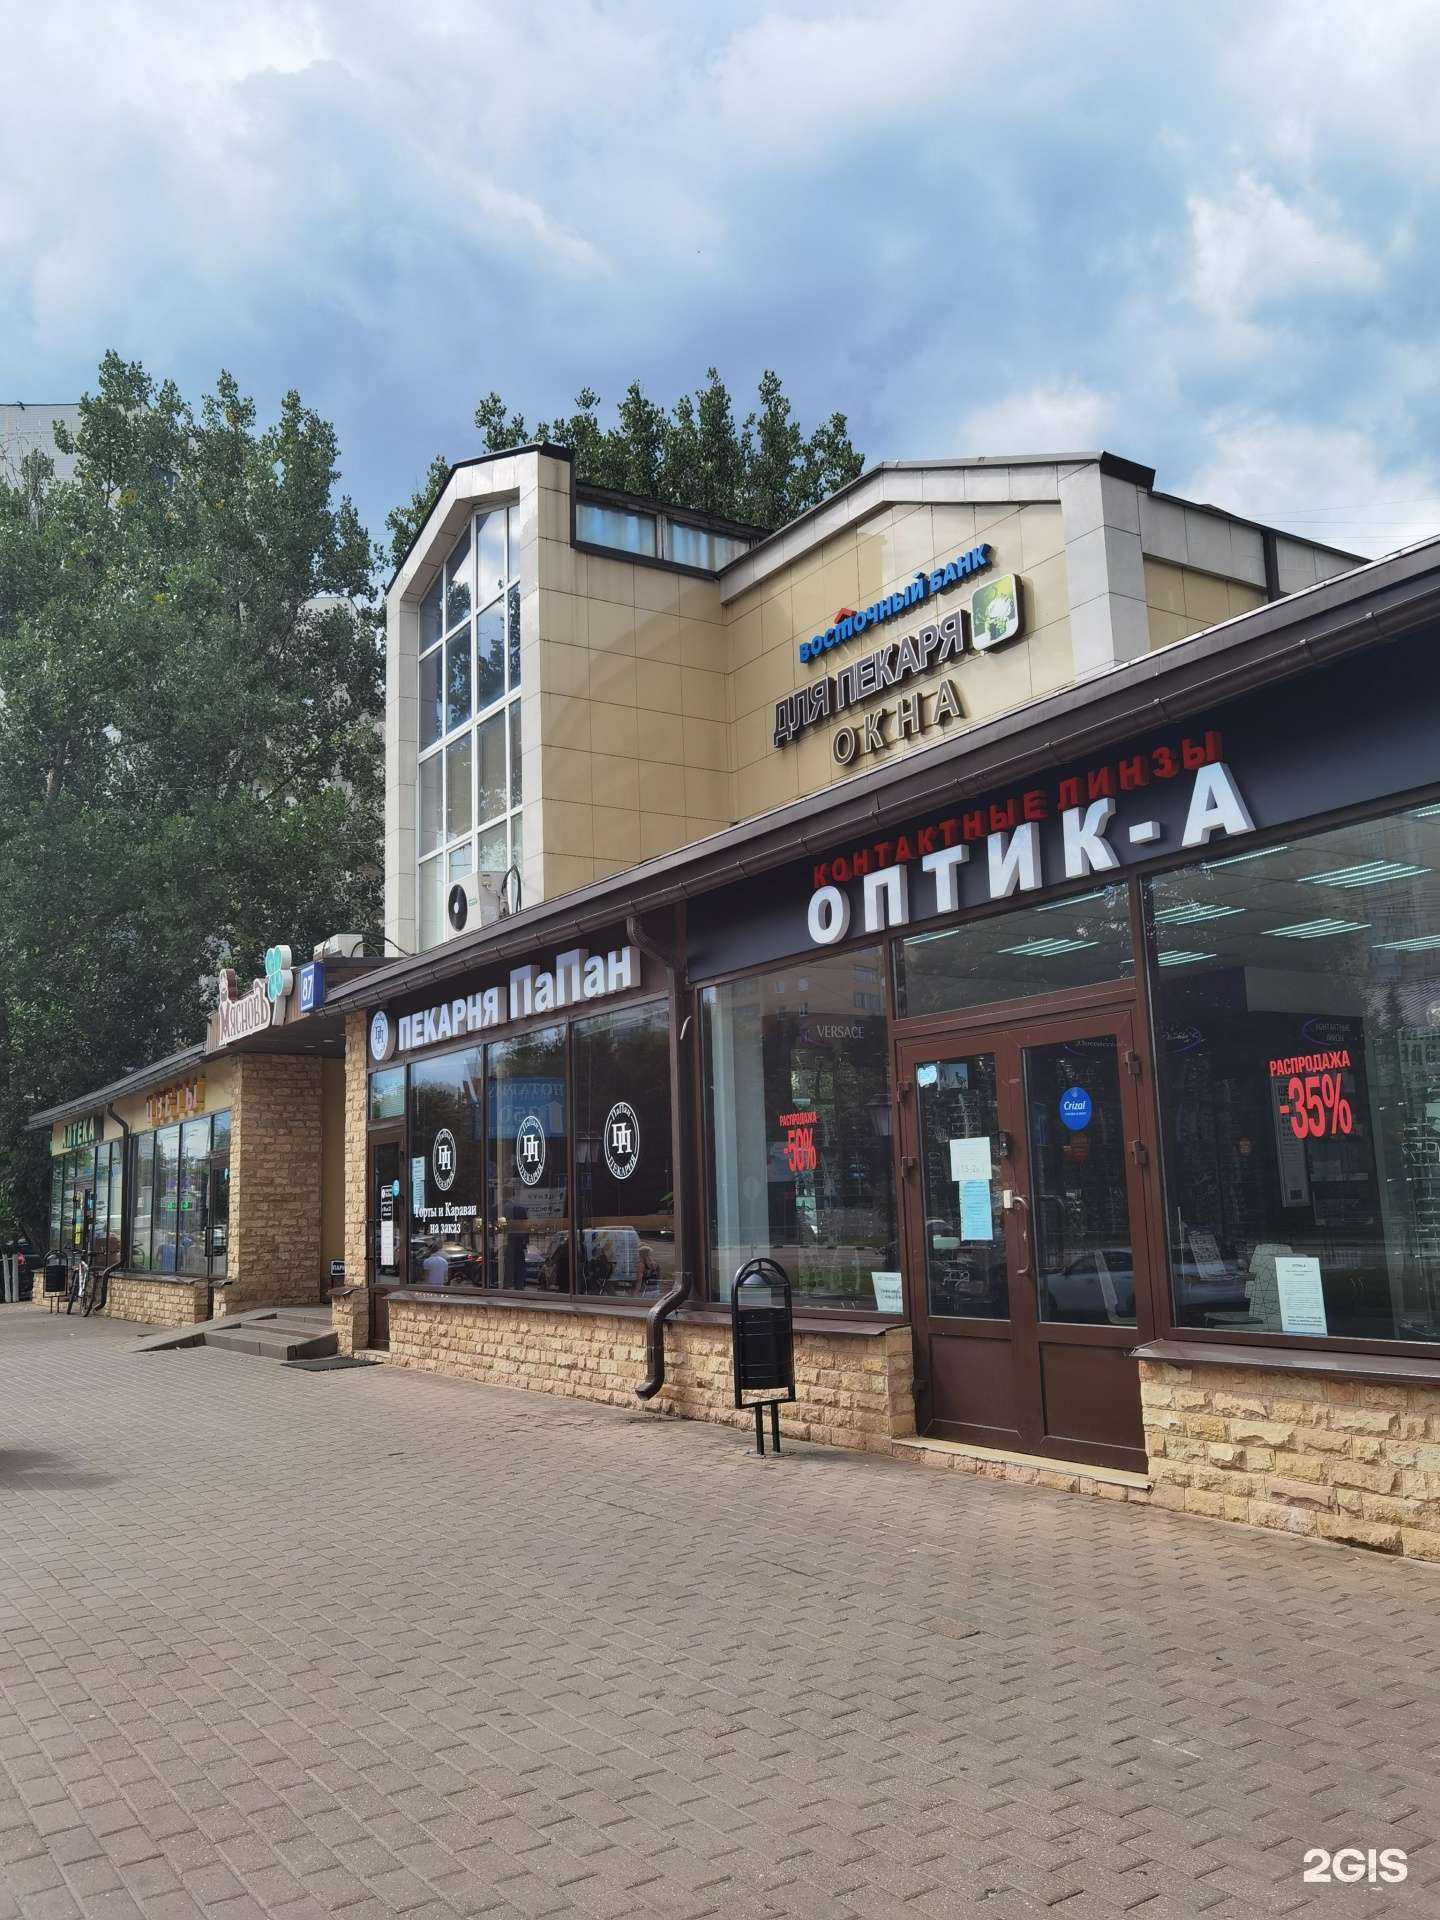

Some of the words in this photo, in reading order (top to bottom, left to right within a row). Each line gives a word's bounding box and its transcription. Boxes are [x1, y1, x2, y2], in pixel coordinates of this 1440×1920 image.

[928, 543, 992, 594] БАНК
[773, 677, 833, 748] ДЛЯ
[837, 609, 967, 711] ПЕКАРЯ
[832, 678, 964, 766] ОКНА
[813, 790, 1049, 888] КОНТАКТНЫЕ
[1057, 731, 1224, 812] ЛИНЗЫ
[808, 761, 1257, 945] ОПТИК-А
[302, 975, 313, 1001] 87
[398, 987, 504, 1051] ПЕКАРНЯ
[509, 946, 638, 1020] ПаПан
[816, 1024, 864, 1039] VERSACE
[1269, 1050, 1351, 1077] РАСПРОДАЖА
[779, 1111, 817, 1127] РАСПРОДАЖА
[1063, 1100, 1086, 1111] Crizal
[1279, 1073, 1352, 1139] -35%
[415, 1205, 437, 1222] Торты
[438, 1207, 444, 1217] и
[430, 1223, 439, 1234] на
[440, 1223, 461, 1234] заказ
